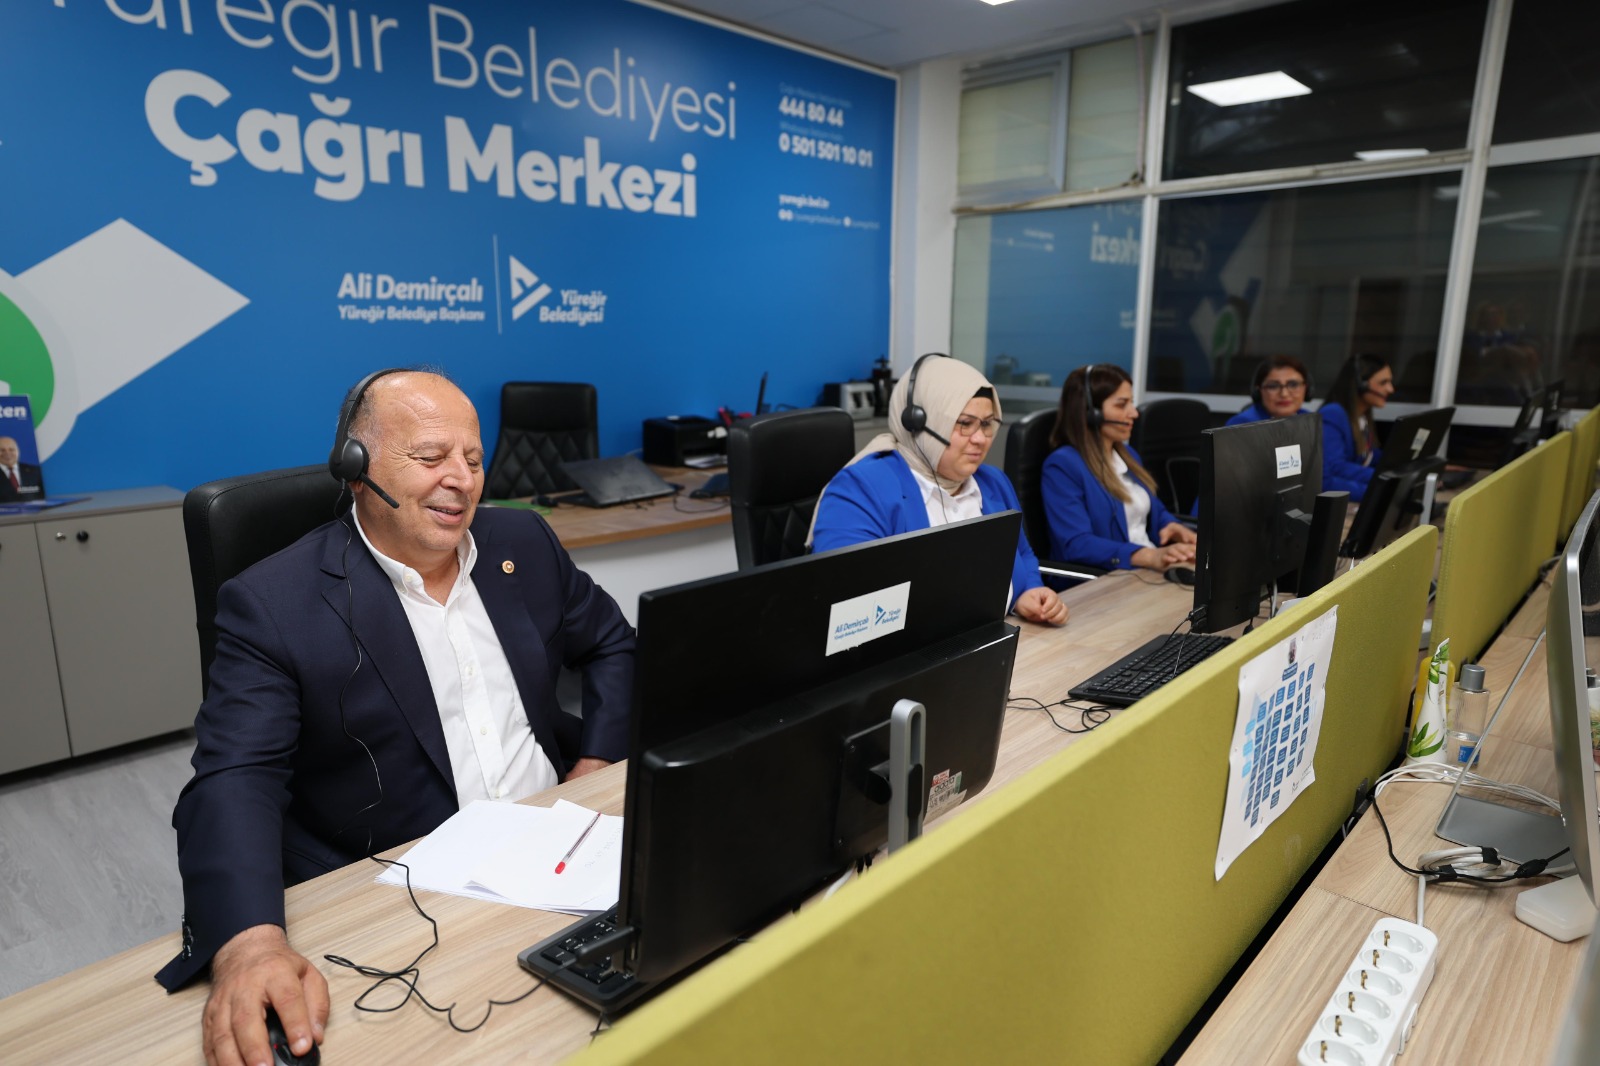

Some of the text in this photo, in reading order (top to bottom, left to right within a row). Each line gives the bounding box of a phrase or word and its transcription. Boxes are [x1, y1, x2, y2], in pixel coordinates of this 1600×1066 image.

[429, 4, 736, 142] Belediyesi
[779, 96, 844, 128] 444 80 44
[144, 69, 697, 218] Çağrı Merkezi
[779, 132, 873, 168] 0 501 501 10 01
[337, 272, 483, 306] Ali Demirçalı
[560, 289, 607, 310] Yüreğir
[338, 304, 485, 324] Yüreğir Belediye Başkanı
[539, 304, 604, 326] Belediyesi
